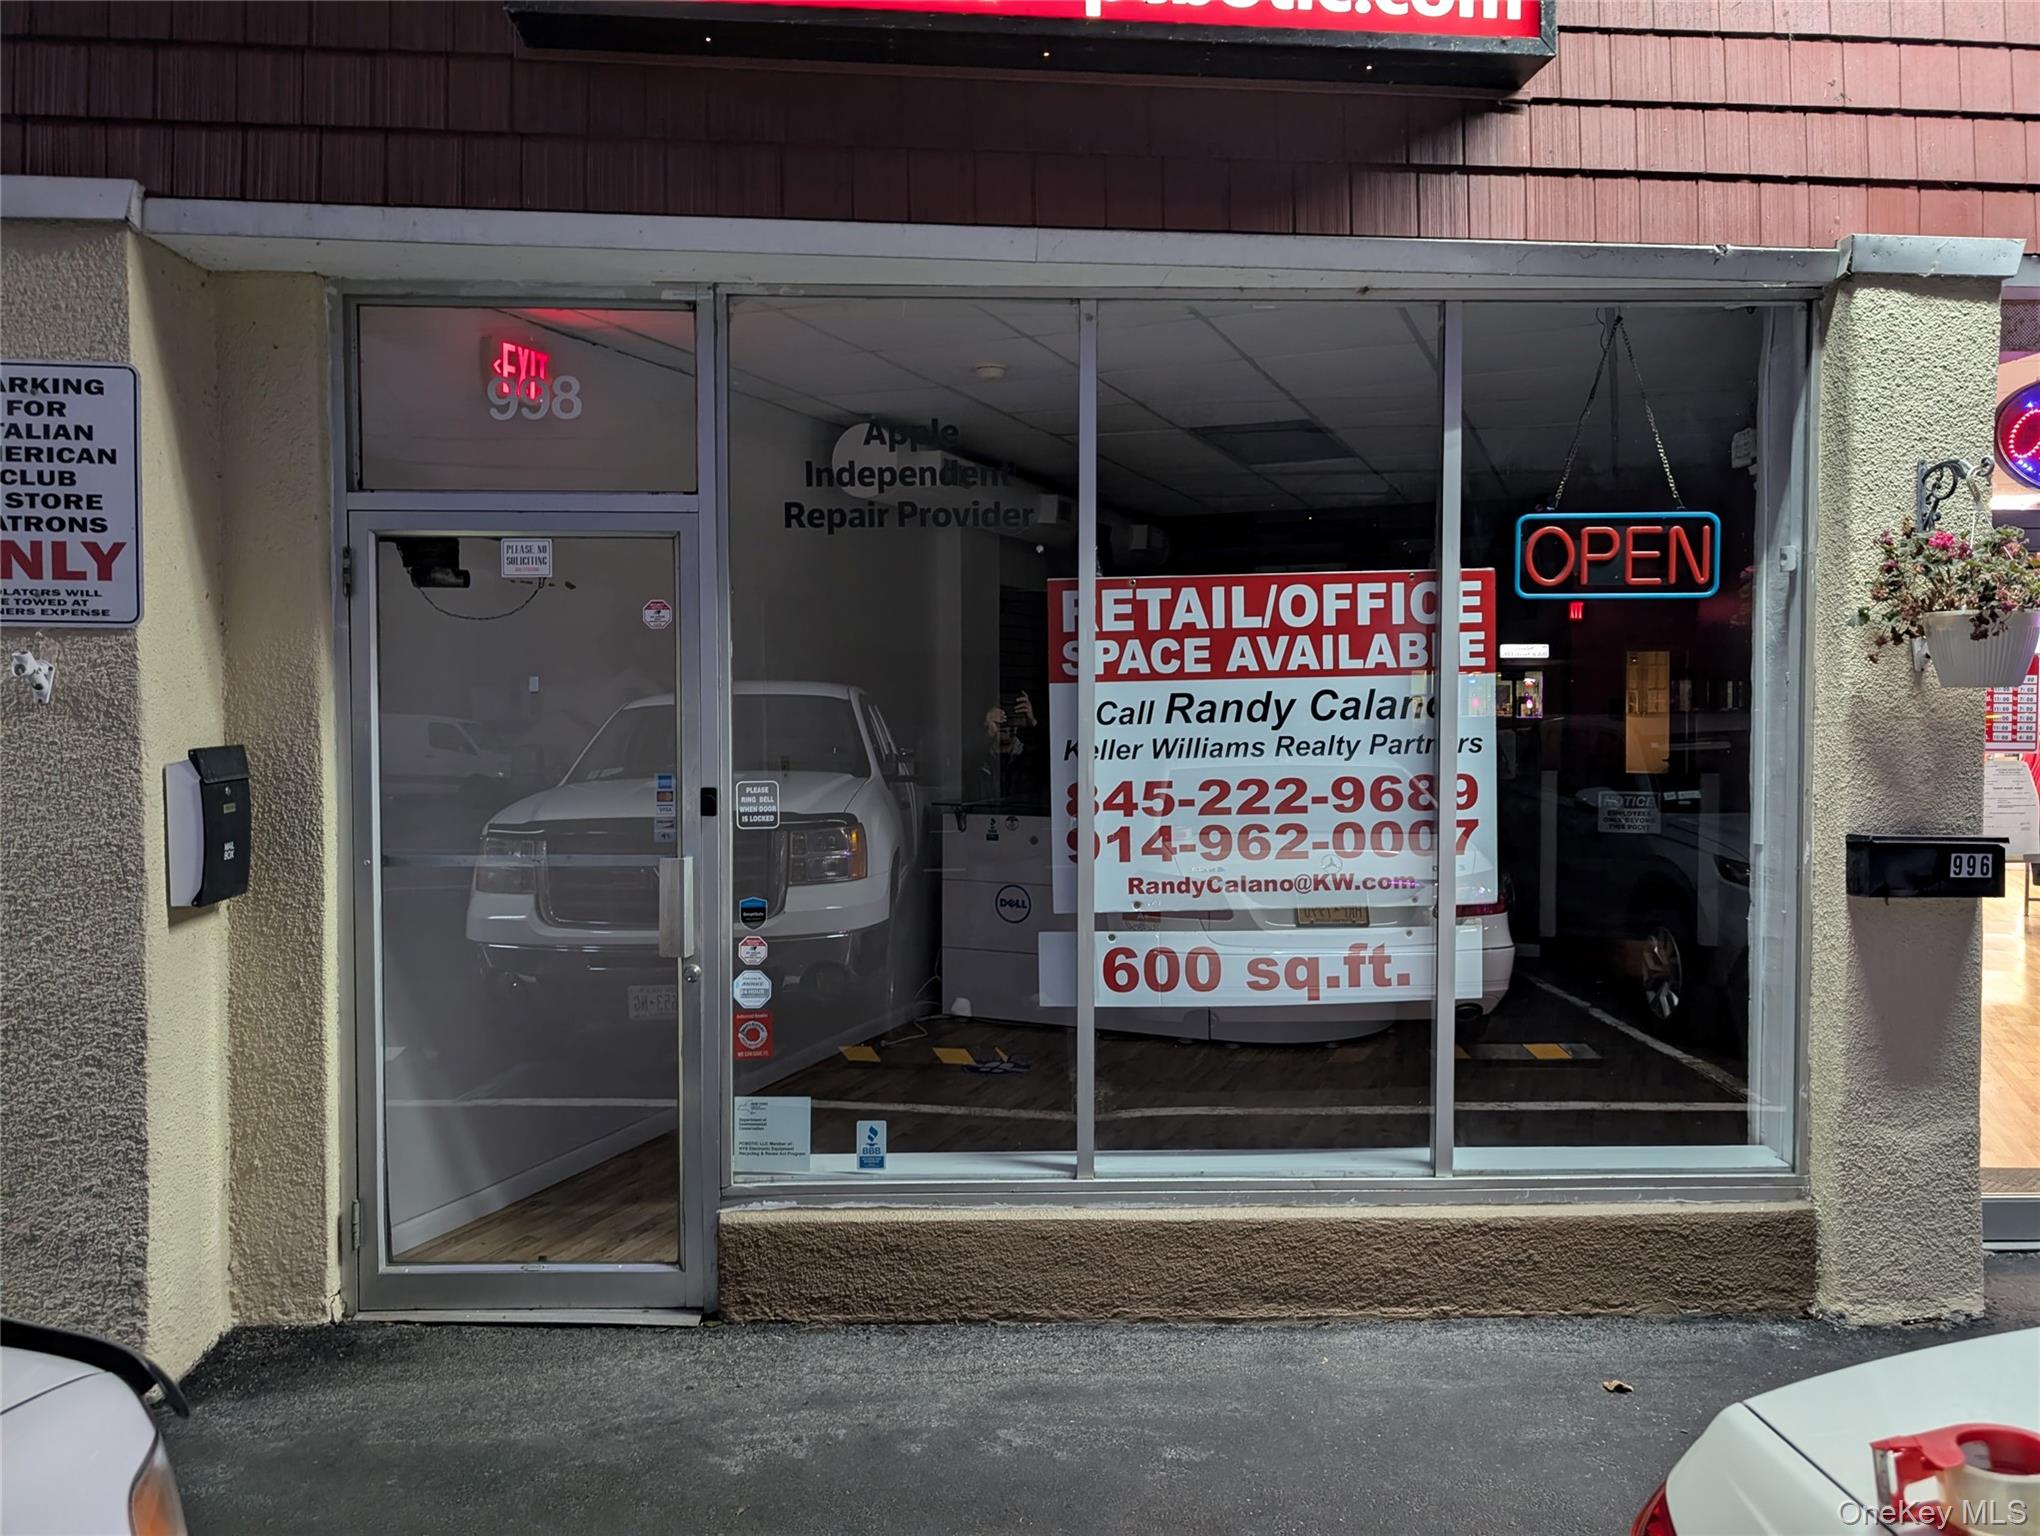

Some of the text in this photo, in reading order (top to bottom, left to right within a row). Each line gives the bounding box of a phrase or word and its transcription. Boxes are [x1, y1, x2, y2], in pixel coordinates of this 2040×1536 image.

[487, 375, 582, 420] 998
[6, 399, 67, 417] FOR
[0, 422, 94, 441] ALIAN
[863, 418, 959, 452] Apple
[0, 445, 118, 465] ERICAN
[0, 468, 78, 487] CLUB
[804, 459, 1012, 493] Independent
[4, 491, 104, 511] STORE
[783, 500, 1035, 535] Repair Provider
[505, 544, 548, 554] PLEASE NO
[1524, 525, 1711, 586] OPEN
[505, 556, 548, 566] SOLICITING
[0, 588, 103, 598] LATORS WILL
[14, 598, 67, 607] TOWED
[72, 599, 89, 607] AT
[41, 608, 111, 617] EXPENSE
[1226, 631, 1486, 673] AVAILABE
[1096, 700, 1155, 725] Call
[1165, 690, 1297, 731] Randy
[1064, 733, 1483, 761] Kller Williams Realty Partrs
[745, 786, 769, 794] PLEASE
[1953, 854, 1990, 876] 996
[1127, 873, 1416, 898] RandyCalano@KW.com
[1000, 898, 1027, 909] DELL
[1103, 942, 1411, 1002] 600 sq.ft.
